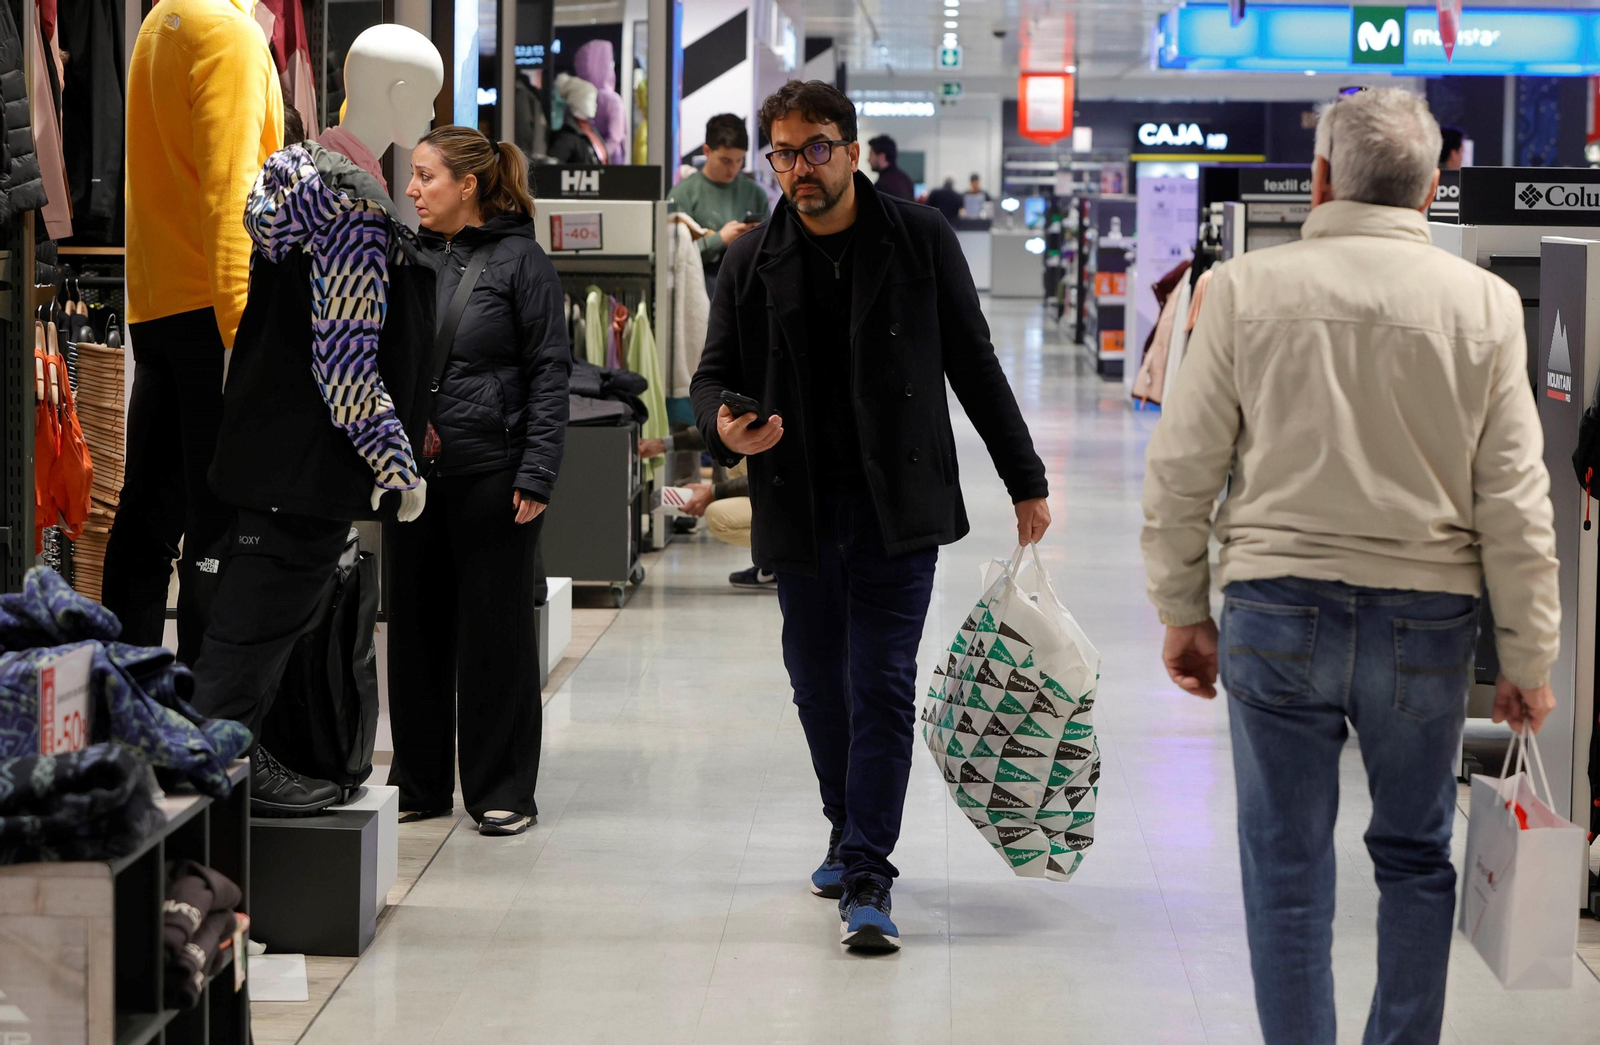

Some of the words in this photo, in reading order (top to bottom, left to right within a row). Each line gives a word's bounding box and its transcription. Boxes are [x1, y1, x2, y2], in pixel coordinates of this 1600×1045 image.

[1413, 29, 1500, 46] moistar
[1137, 122, 1204, 146] CAJA
[1264, 179, 1298, 192] textil
